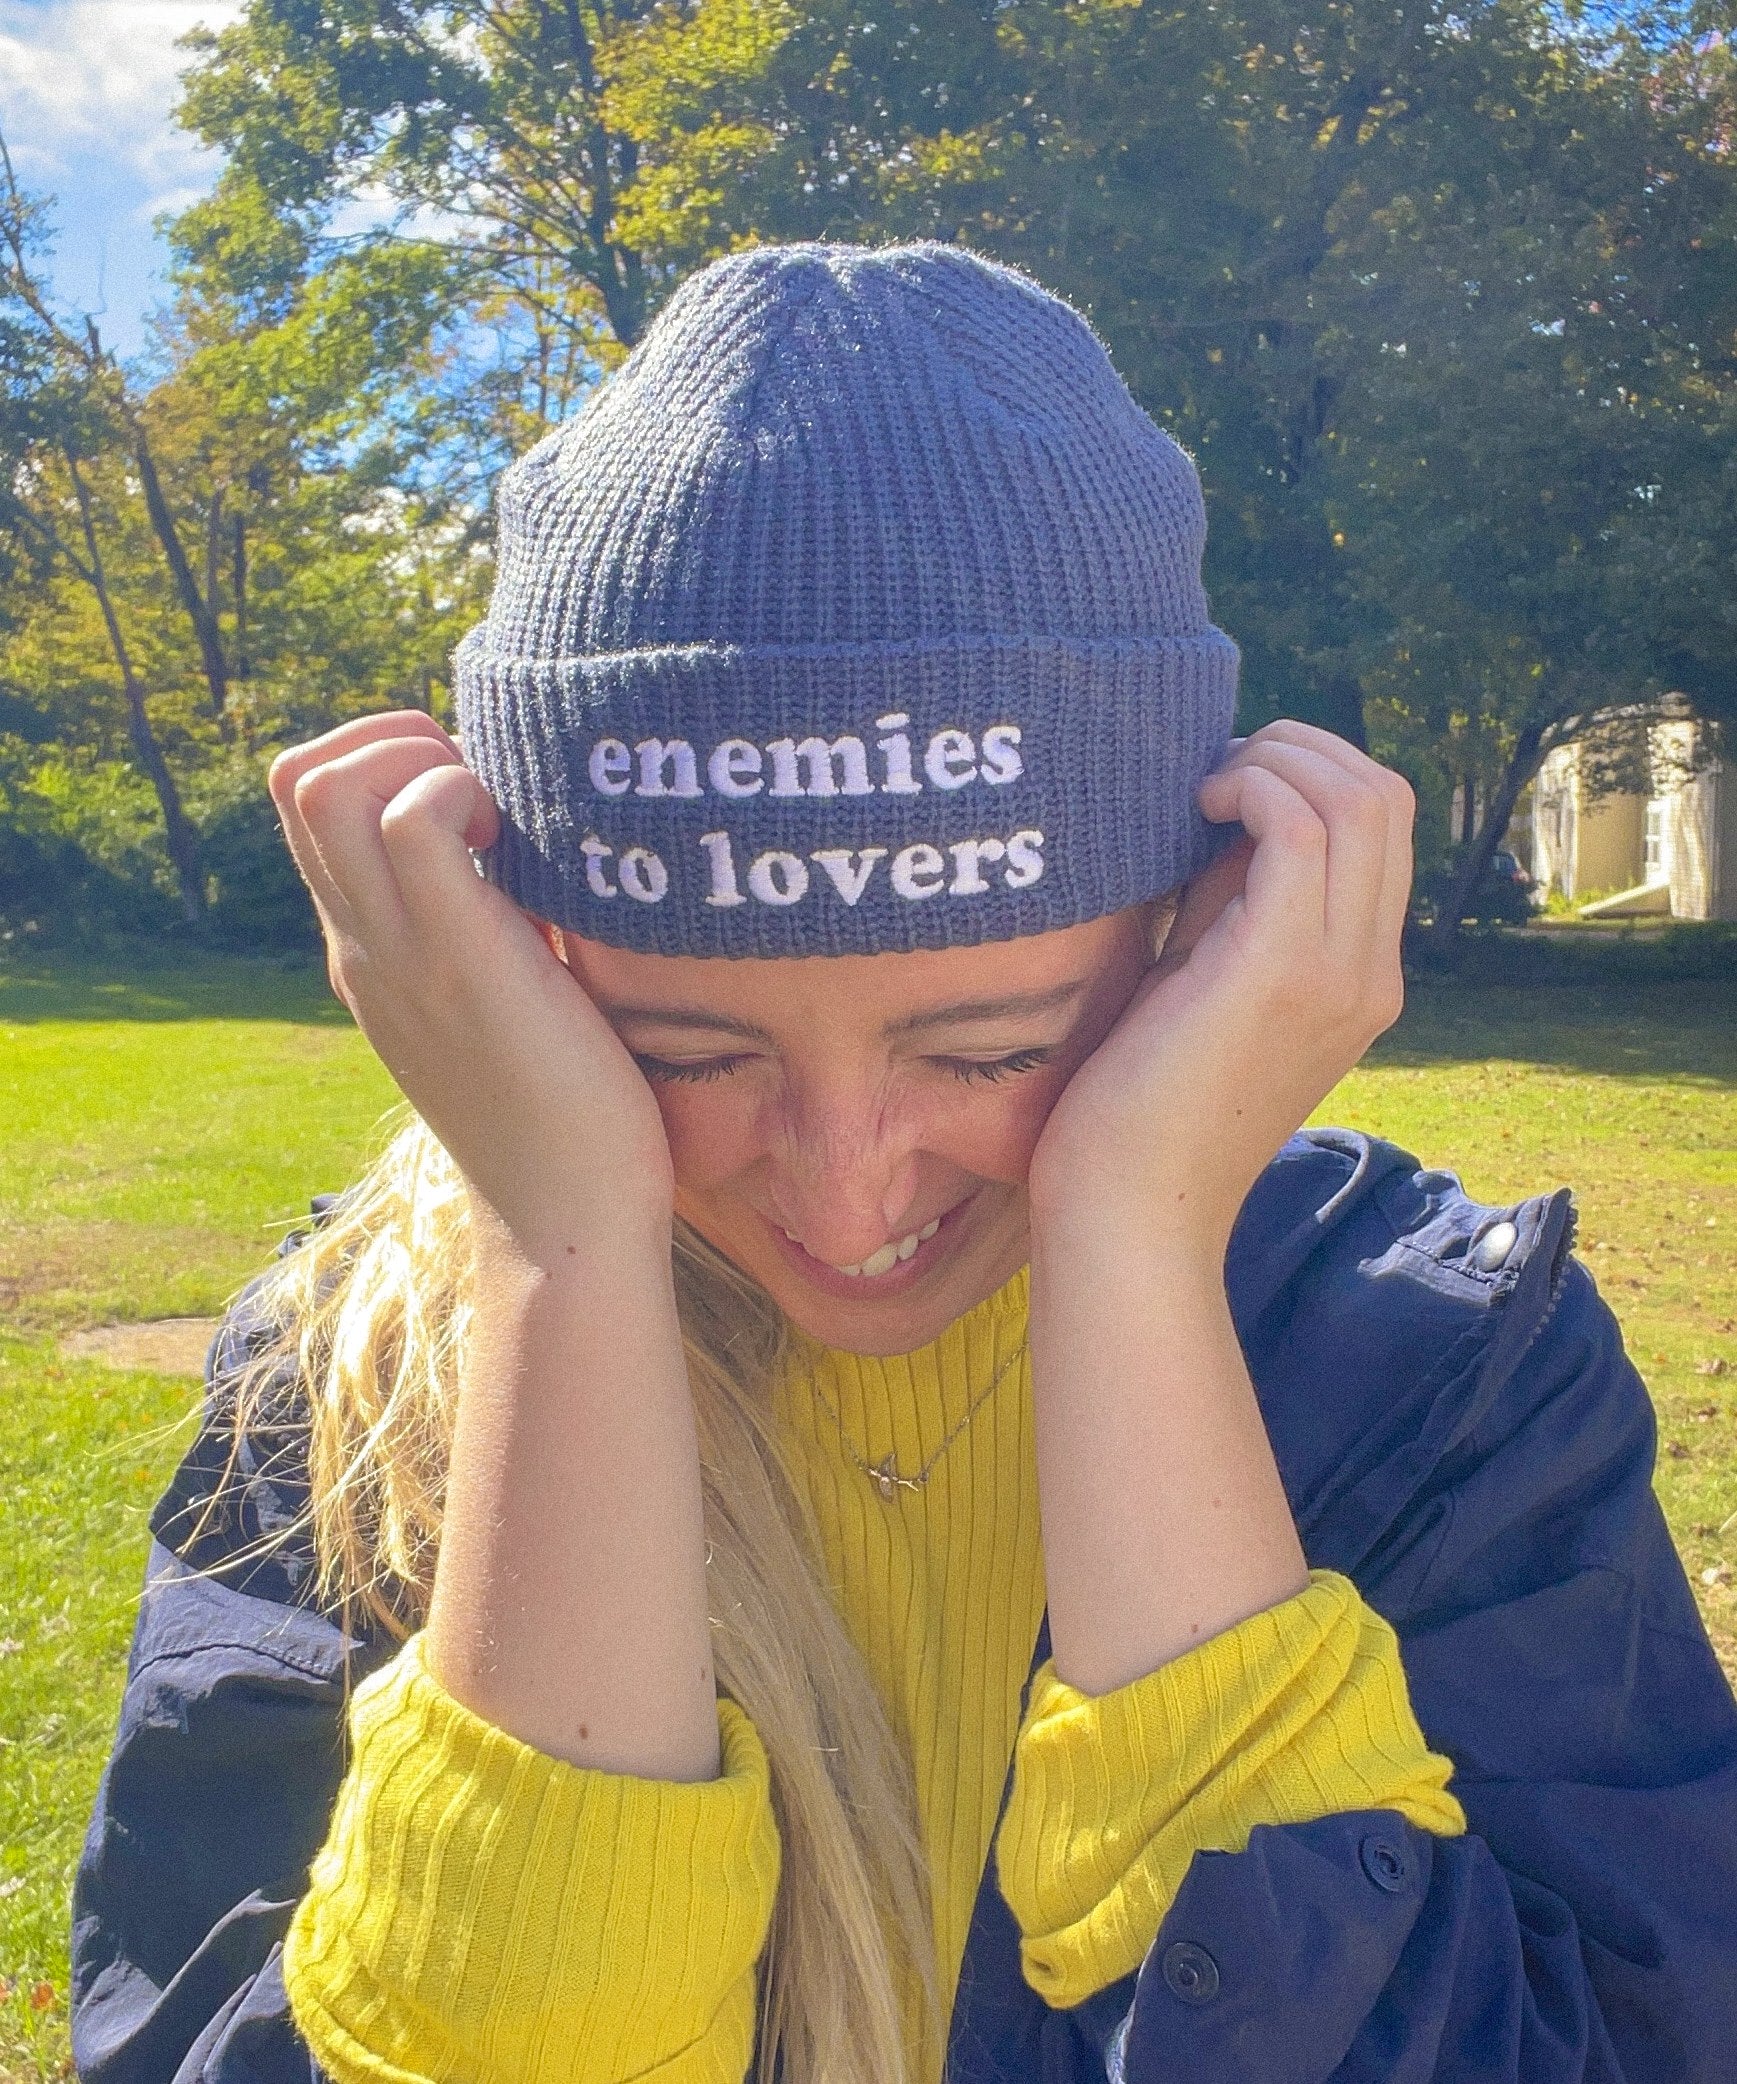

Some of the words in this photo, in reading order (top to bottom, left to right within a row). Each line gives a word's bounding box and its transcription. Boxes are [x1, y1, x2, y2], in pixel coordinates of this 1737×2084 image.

[588, 712, 1024, 798] enemies
[580, 835, 668, 903] to
[700, 830, 1045, 907] lovers
